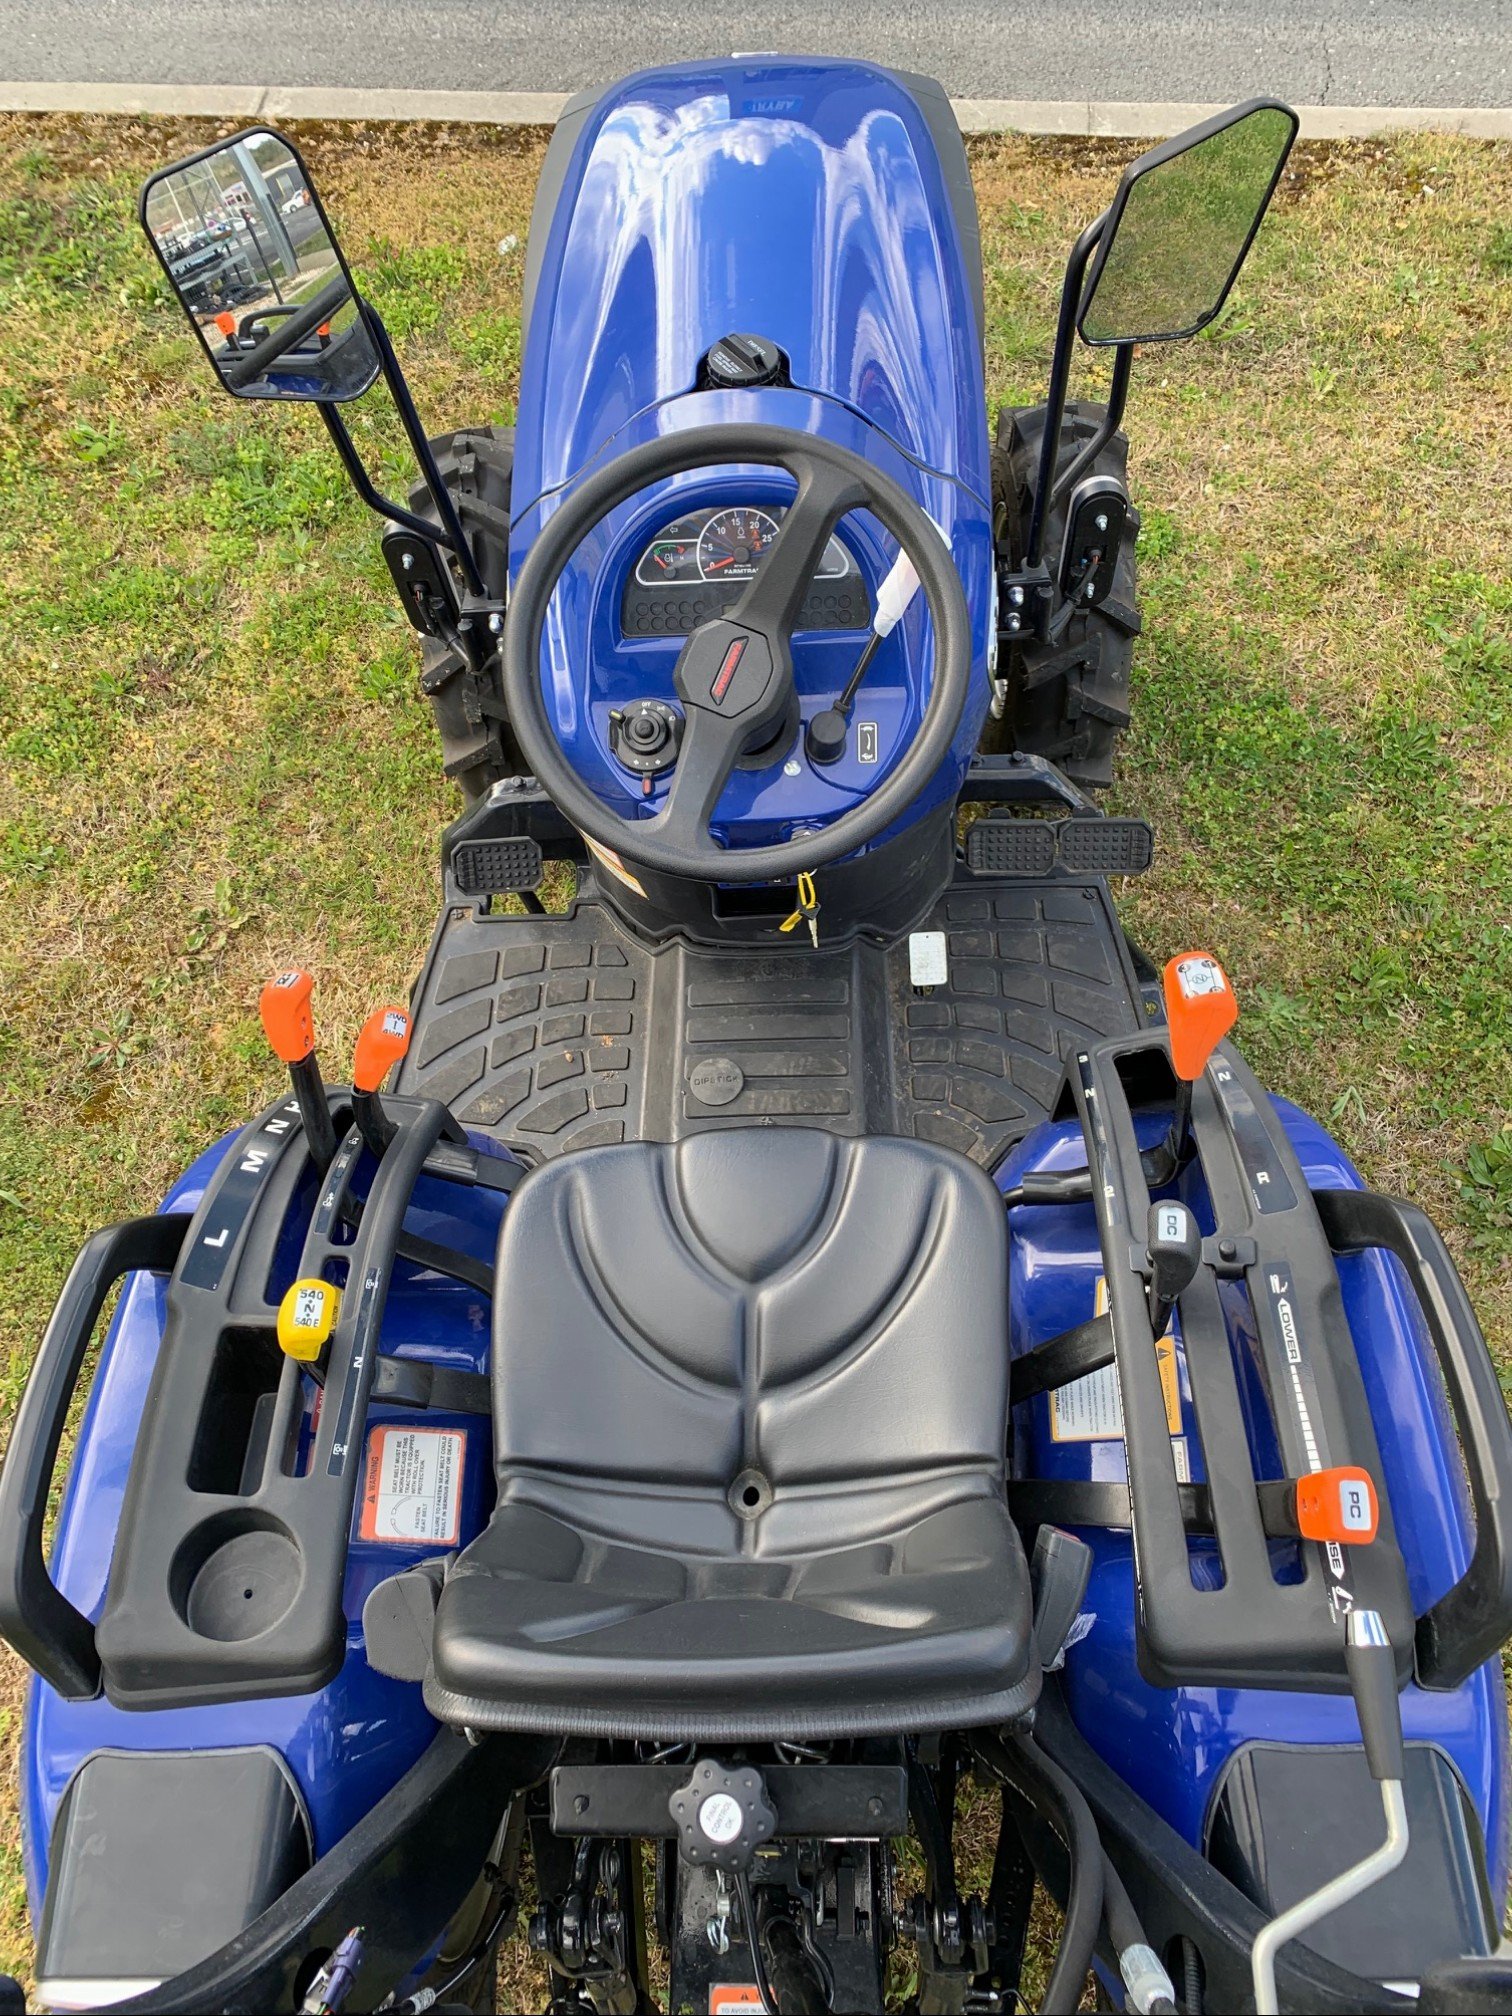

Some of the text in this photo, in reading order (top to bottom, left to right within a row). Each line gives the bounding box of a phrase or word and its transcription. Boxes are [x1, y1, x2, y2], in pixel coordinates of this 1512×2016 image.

[731, 518, 740, 526] 15
[750, 521, 760, 529] 20
[717, 527, 726, 535] 10
[762, 534, 772, 543] 25
[708, 543, 713, 551] 5
[1218, 1071, 1231, 1081] N
[1085, 1088, 1094, 1098] N
[265, 1118, 290, 1135] N
[240, 1150, 269, 1173] M
[1167, 1215, 1177, 1235] DC
[203, 1229, 229, 1247] L
[300, 1289, 324, 1300] 540
[304, 1304, 315, 1313] N
[294, 1317, 319, 1327] 540 E
[1280, 1304, 1299, 1360] LOWER
[353, 1357, 363, 1368] N
[446, 1456, 452, 1465] OR
[369, 1456, 379, 1491] WARNING
[1348, 1491, 1361, 1519] PC
